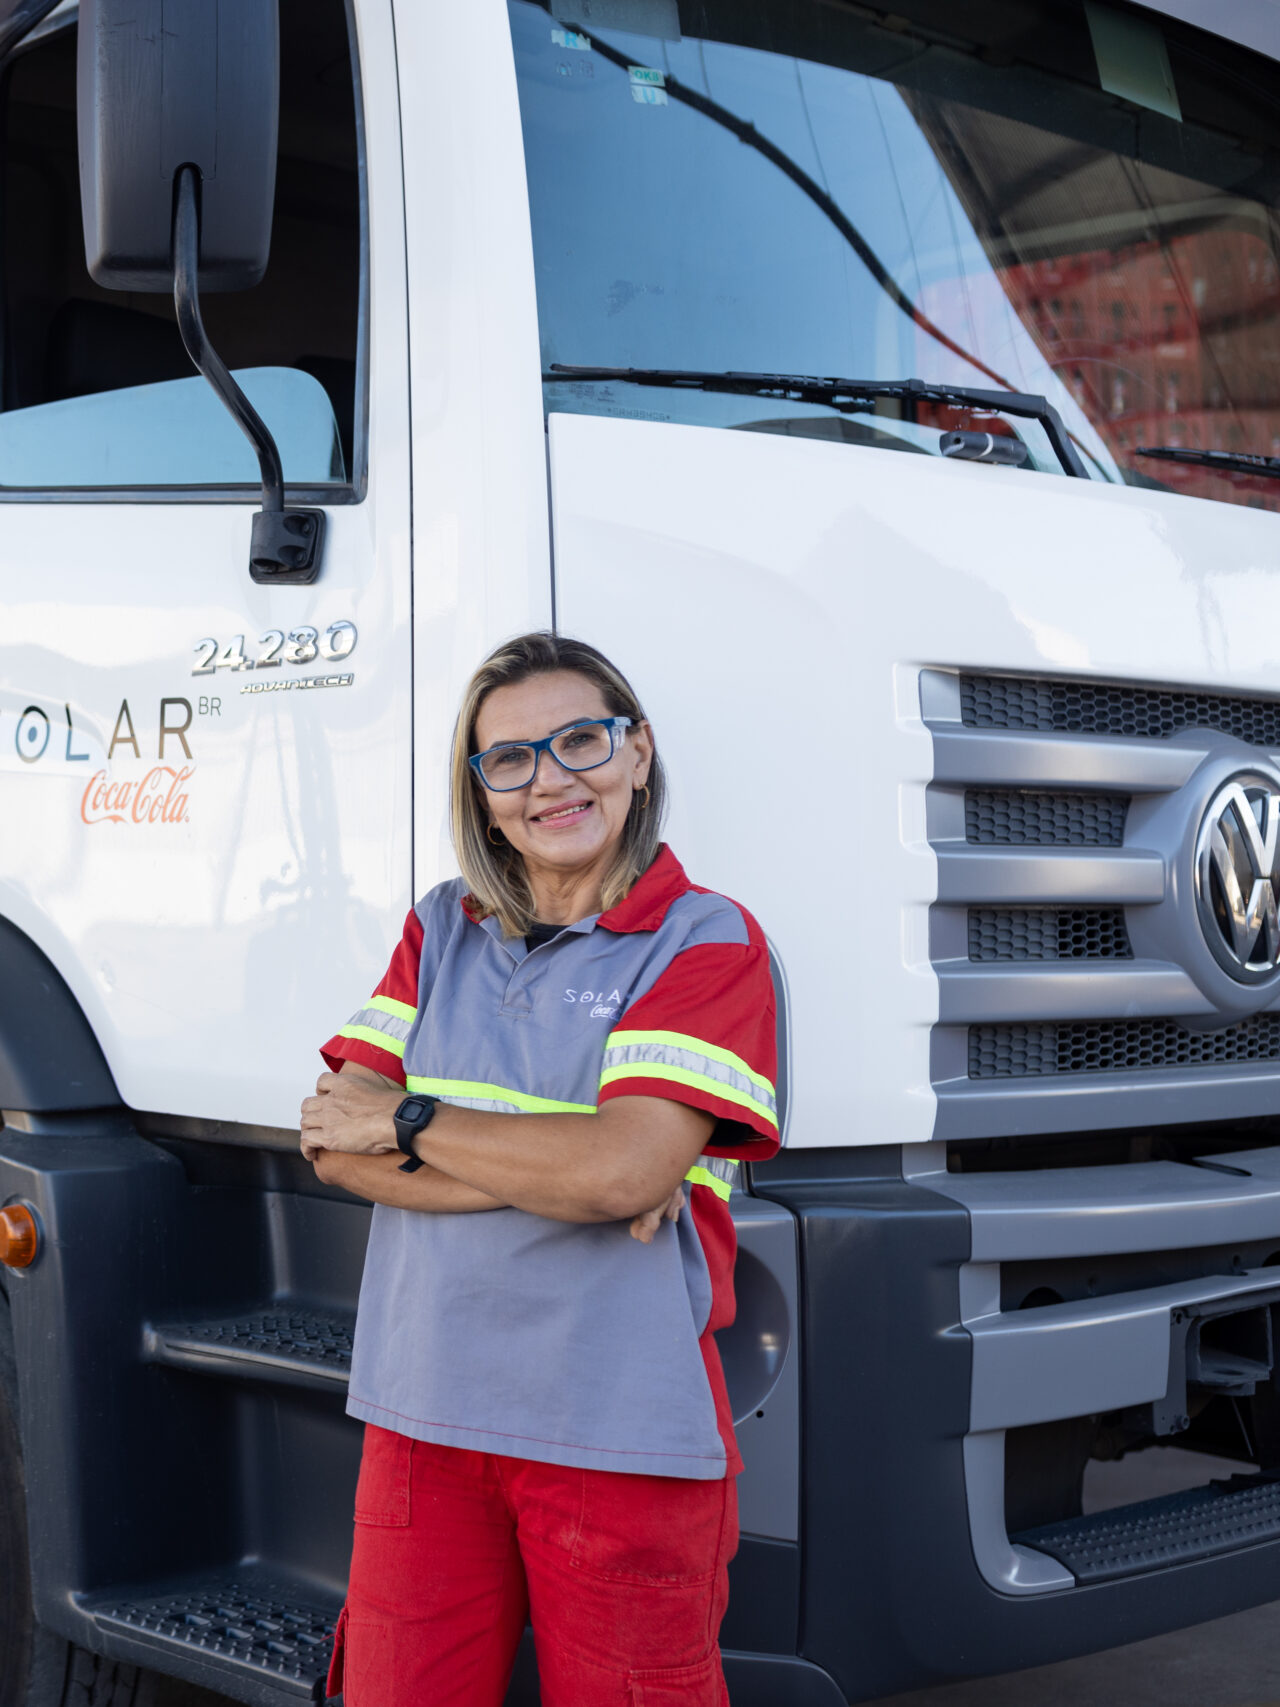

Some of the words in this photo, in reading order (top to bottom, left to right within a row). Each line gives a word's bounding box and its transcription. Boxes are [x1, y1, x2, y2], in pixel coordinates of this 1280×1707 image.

[191, 619, 358, 677] 24.280
[239, 672, 356, 695] ADVANTECH
[199, 696, 222, 716] BR
[81, 765, 196, 825] Coca-Cola
[563, 988, 621, 1004] SOLA
